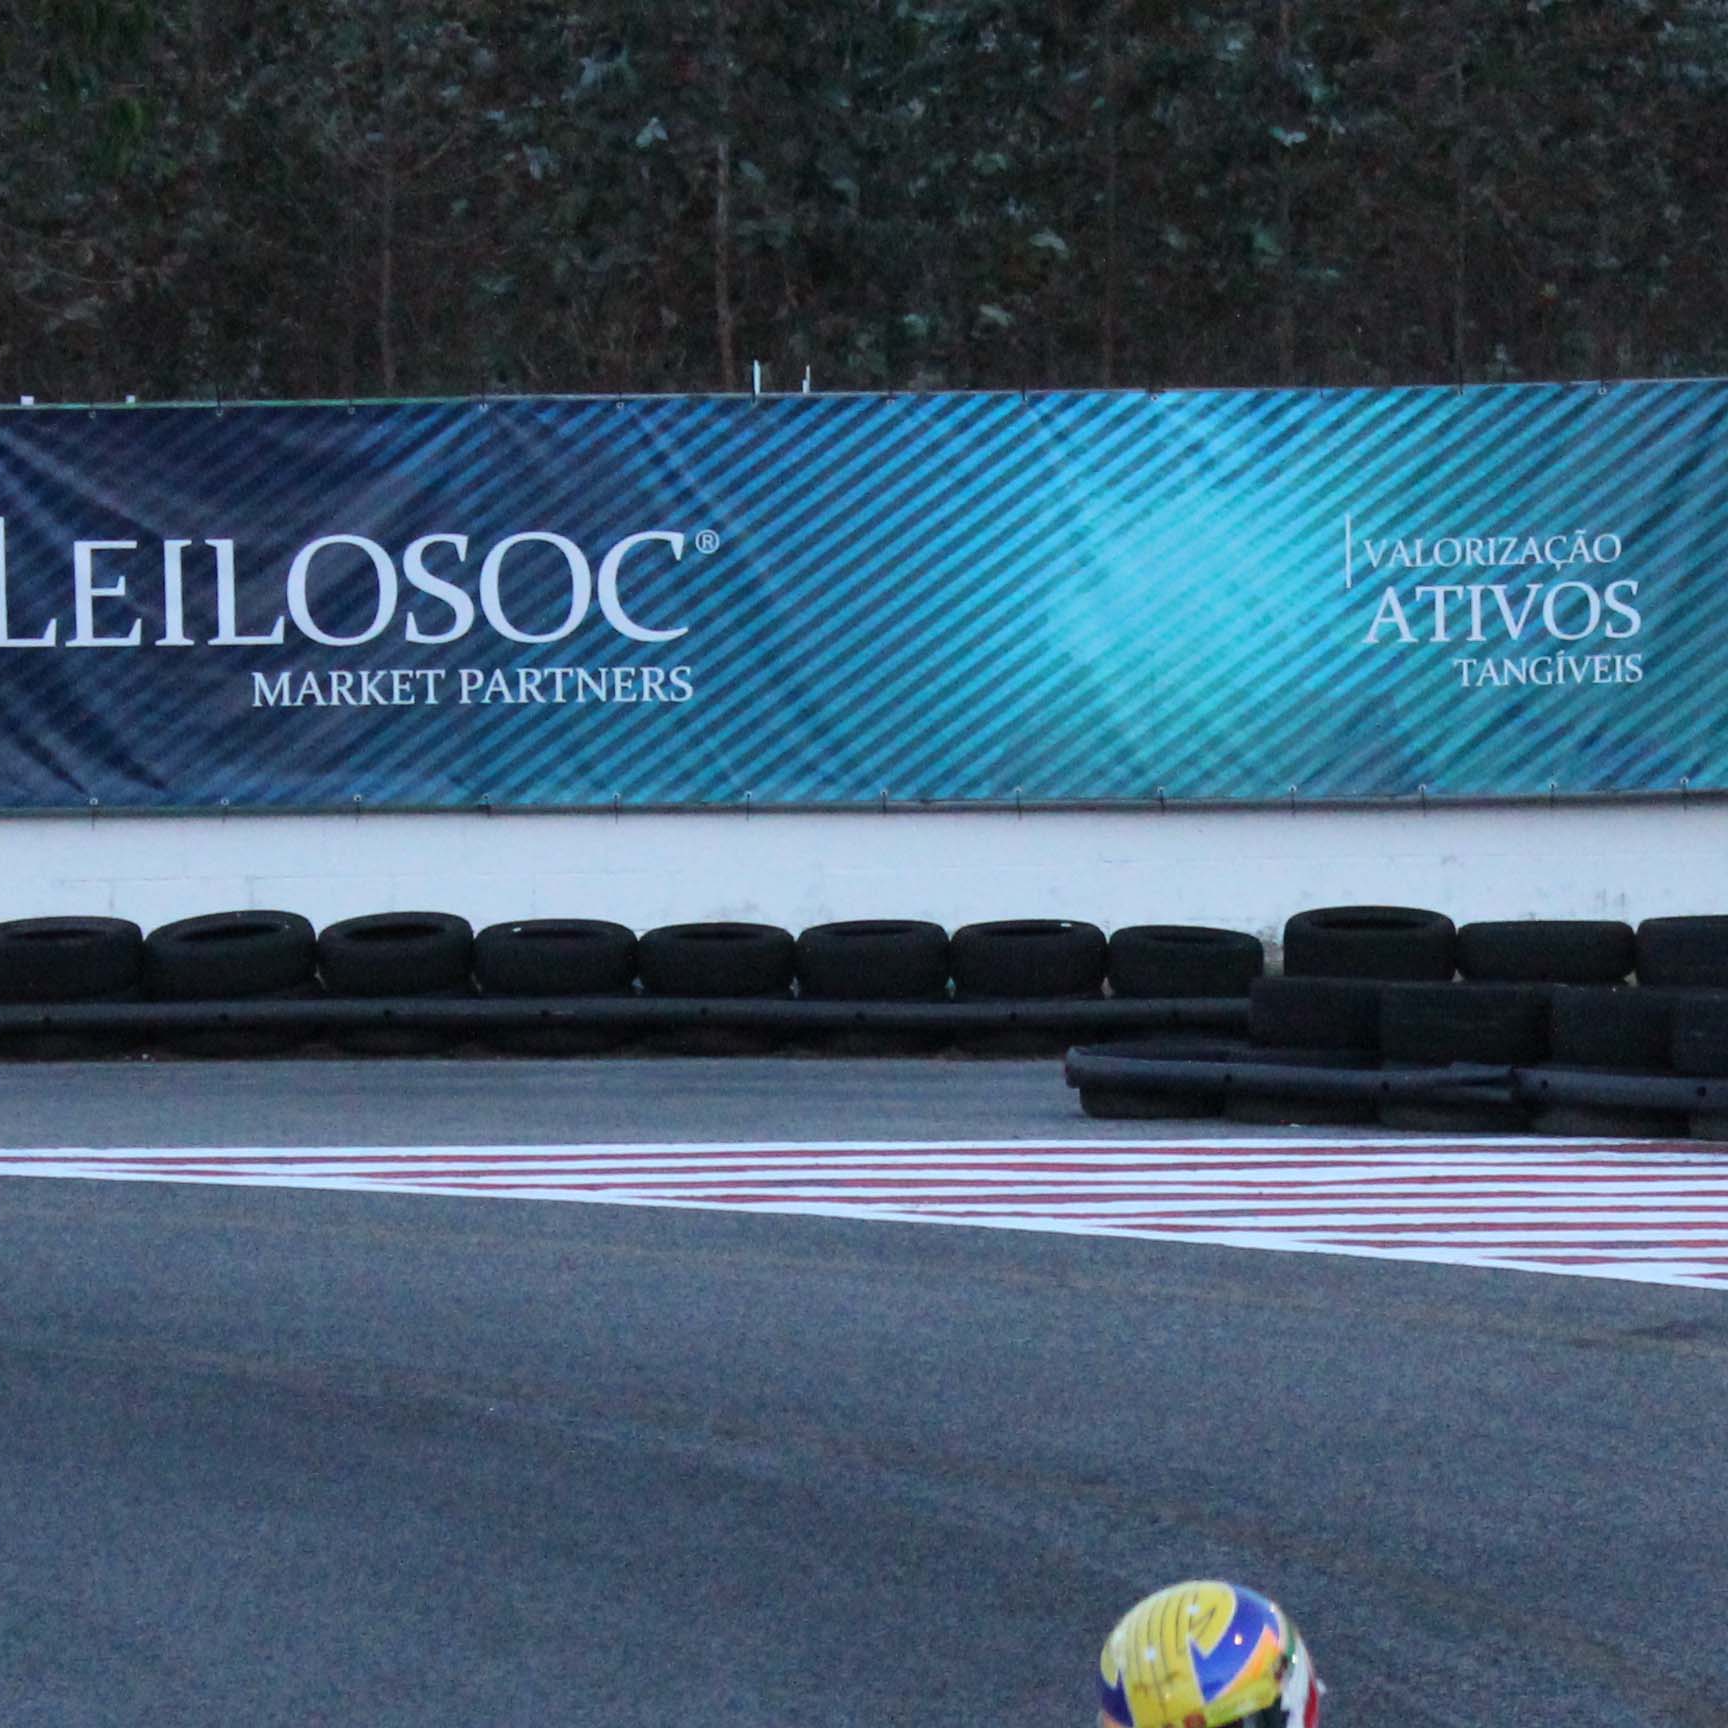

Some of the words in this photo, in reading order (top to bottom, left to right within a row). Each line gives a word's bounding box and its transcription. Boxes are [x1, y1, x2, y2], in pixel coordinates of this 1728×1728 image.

[1363, 530, 1622, 571] VALORIZAÇÃO
[1362, 579, 1642, 644] ATIVOS
[252, 669, 446, 707] MARKET
[458, 666, 694, 704] PARTNERS
[1454, 650, 1643, 688] TANGÍVEIS
